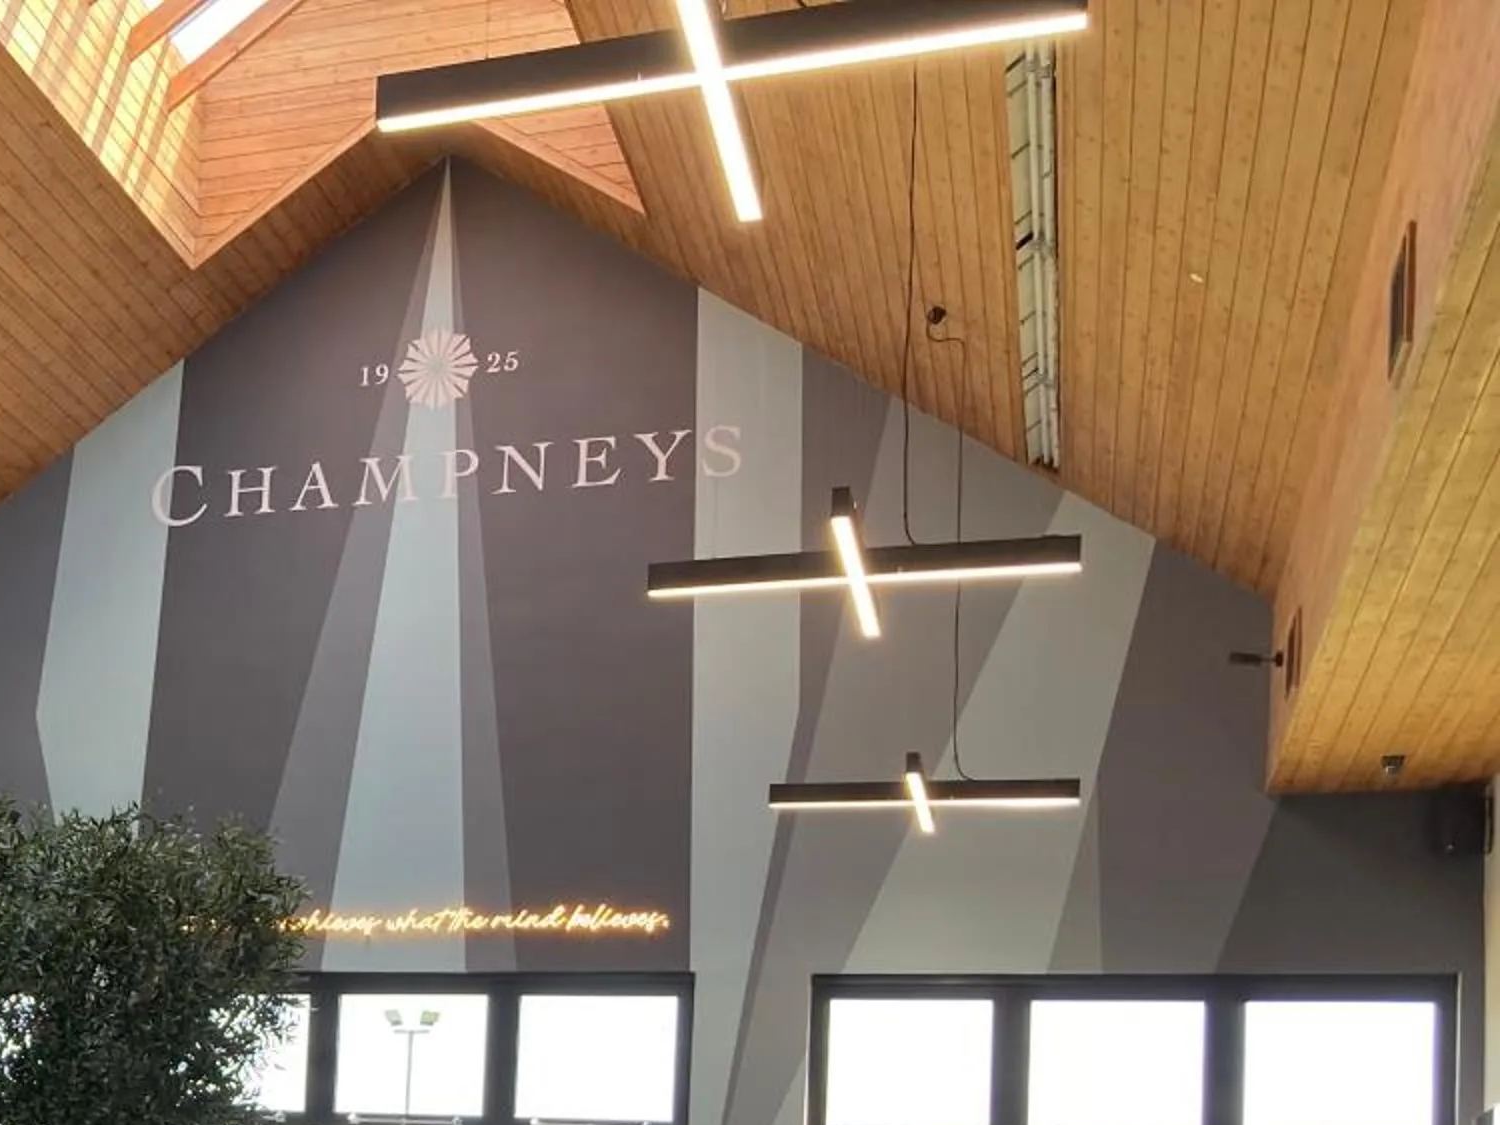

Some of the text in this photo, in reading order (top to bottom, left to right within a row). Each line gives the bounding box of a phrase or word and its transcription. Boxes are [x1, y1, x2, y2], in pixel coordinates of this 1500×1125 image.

[359, 350, 519, 387] 19 25
[151, 425, 742, 527] CHAMPNEYS
